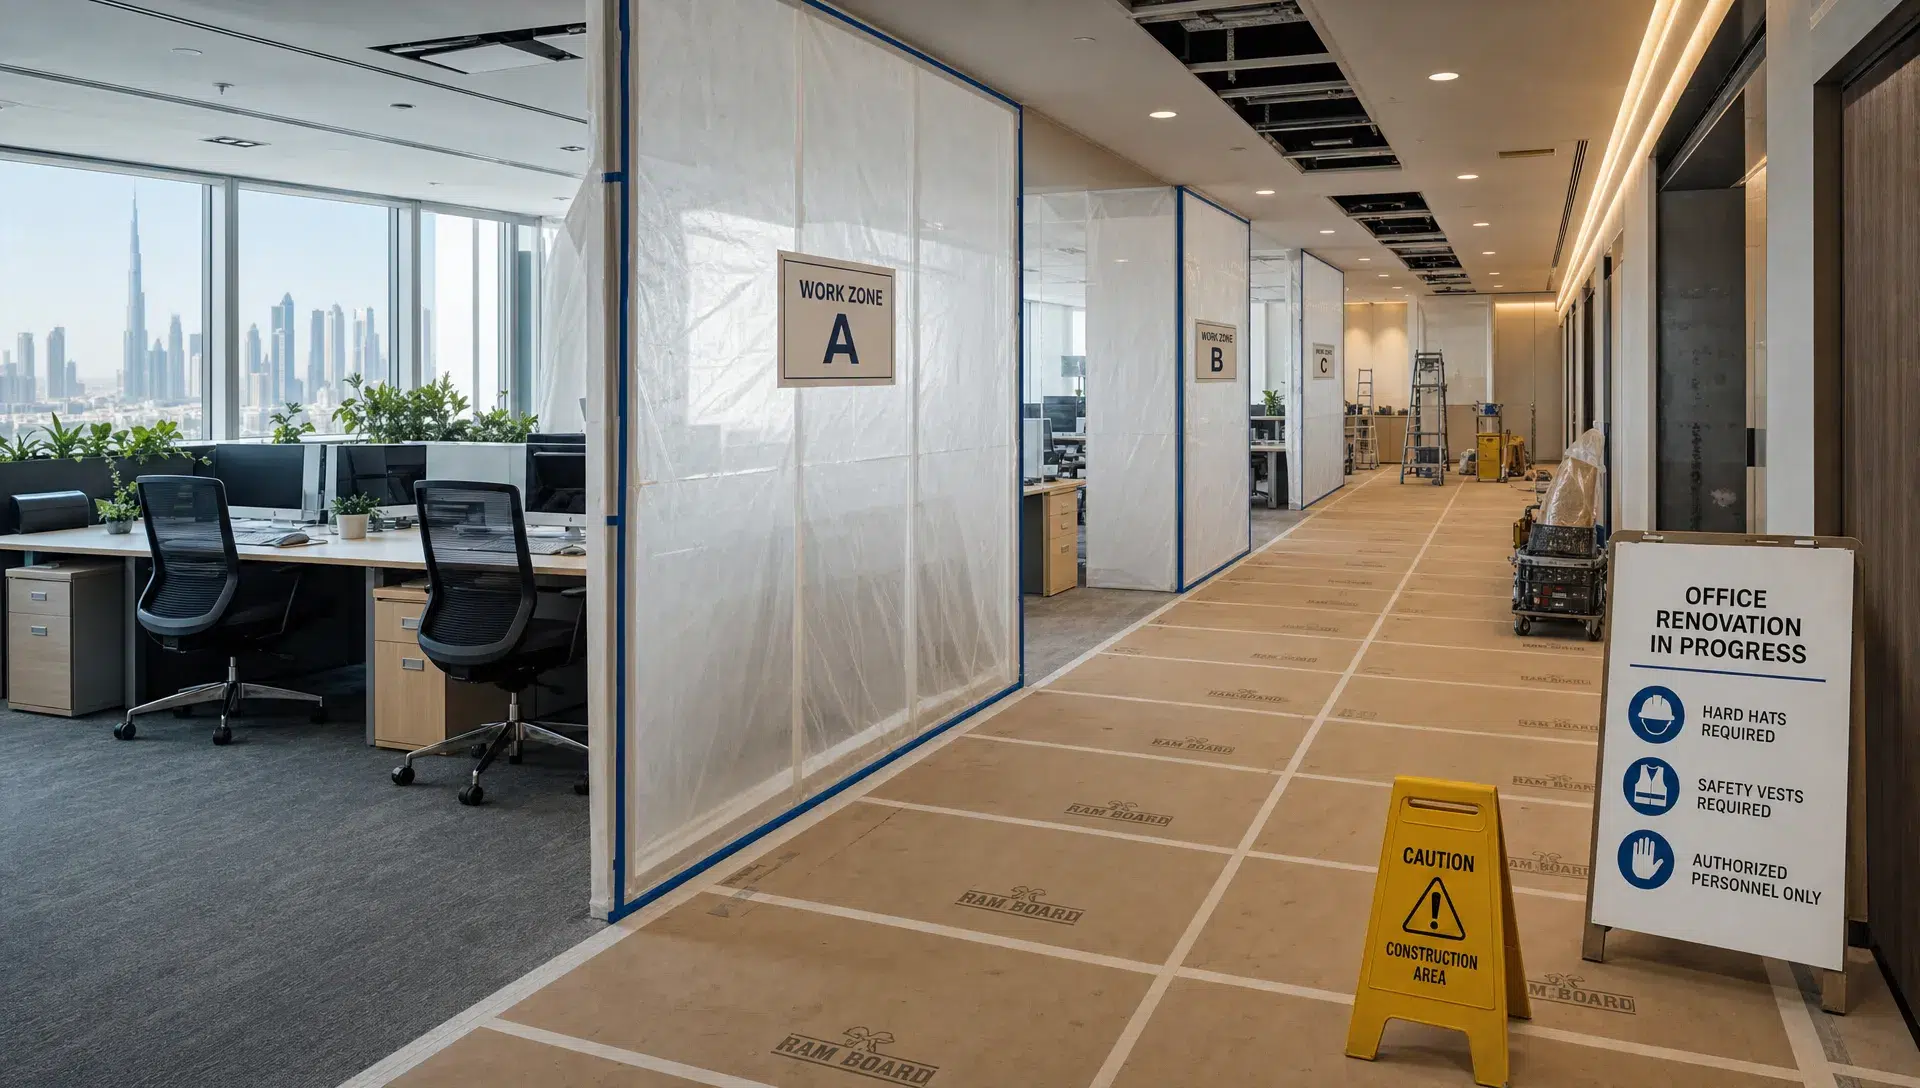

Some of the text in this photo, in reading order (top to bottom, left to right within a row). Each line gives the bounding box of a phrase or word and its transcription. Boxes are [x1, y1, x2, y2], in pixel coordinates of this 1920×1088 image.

[799, 279, 883, 306] WORK ZONE
[822, 313, 860, 365] A
[1201, 331, 1233, 343] WORK ZONE
[1211, 347, 1223, 372] B
[1320, 357, 1328, 374] C
[1685, 586, 1767, 609] OFFICE
[1656, 609, 1801, 637] RENOVATION
[1650, 634, 1807, 664] IN PROGRESS
[1702, 705, 1787, 726] HARD HATS
[1701, 723, 1776, 743] REQUIRED
[1512, 775, 1547, 787] RAM
[1698, 778, 1804, 804] SAFETY VESTS
[1066, 803, 1170, 825] RAM BOARD
[1697, 796, 1772, 818] REQUIRED
[1402, 847, 1475, 873] CAUTION
[1509, 859, 1533, 871] AM
[1692, 853, 1788, 880] AUTHORIZED
[1691, 872, 1822, 906] PERSONNEL ONLY
[957, 891, 1081, 922] RAM BOARD
[1386, 941, 1478, 971] CONSTRUCTION
[1413, 966, 1447, 985] AREA
[1556, 986, 1634, 1011] BOARD
[775, 1035, 933, 1086] RAM BOARD
